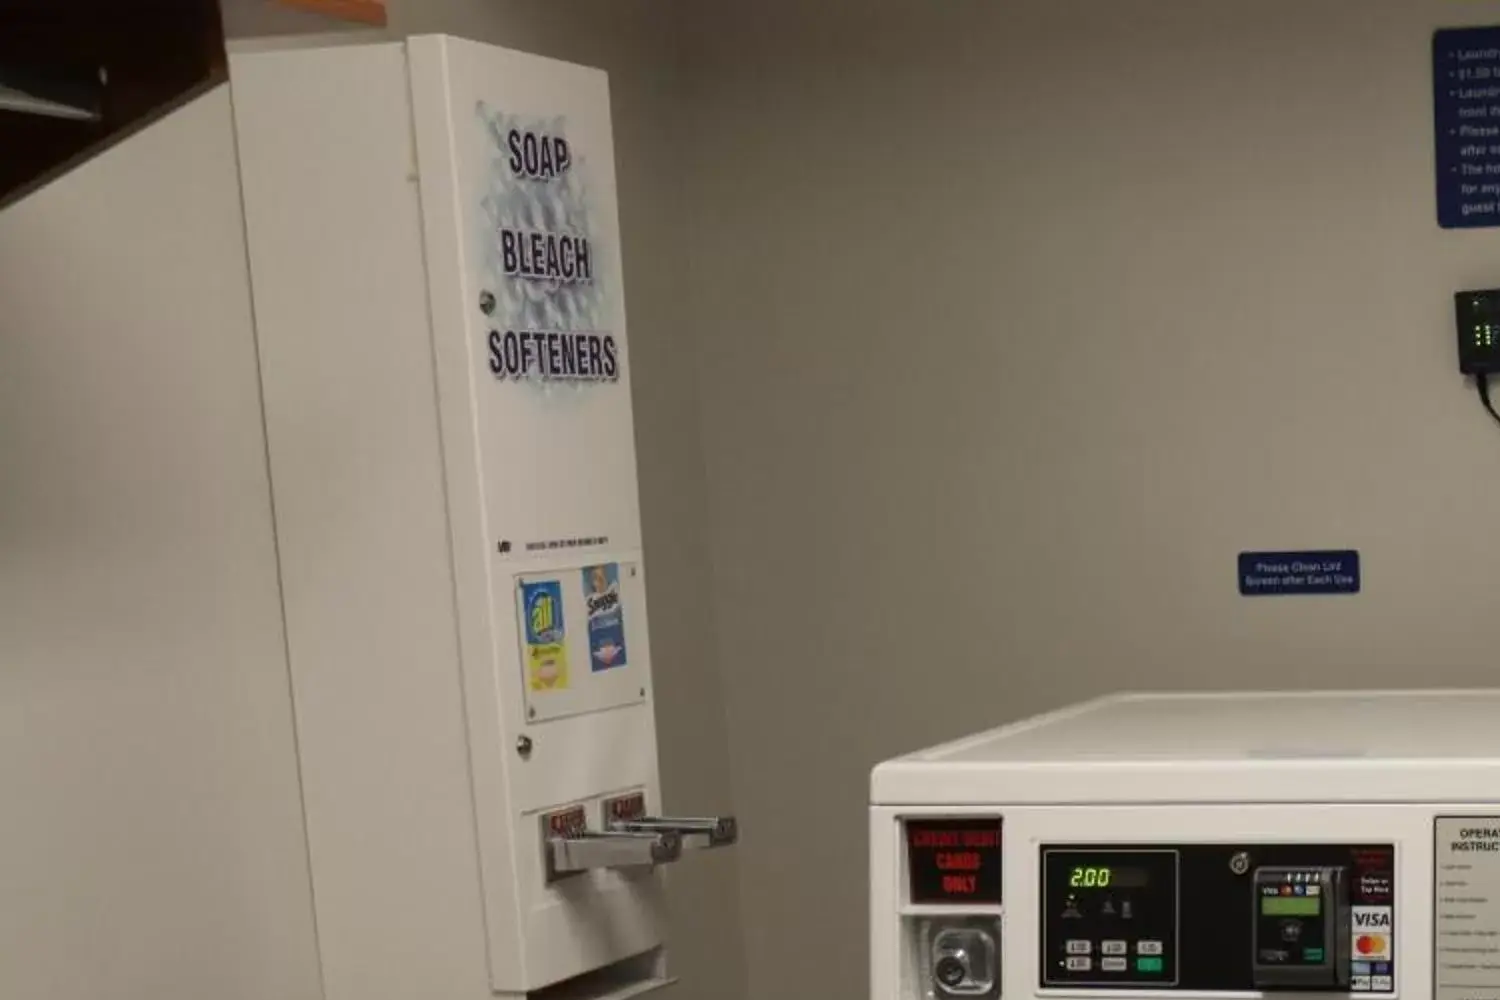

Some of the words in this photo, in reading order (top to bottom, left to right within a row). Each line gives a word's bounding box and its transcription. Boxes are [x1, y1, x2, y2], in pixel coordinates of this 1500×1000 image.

[1460, 125, 1499, 137] Please
[509, 129, 571, 176] SOAP
[1461, 144, 1487, 156] after
[1461, 163, 1482, 175] The
[1461, 183, 1477, 194] for
[1482, 183, 1500, 195] any
[1462, 201, 1494, 214] guest
[501, 229, 591, 279] BLEACH
[488, 330, 617, 378] SOFTENERS
[942, 875, 976, 894] ONLY
[1070, 868, 1111, 887] 2.00
[1354, 912, 1390, 926] VISA
